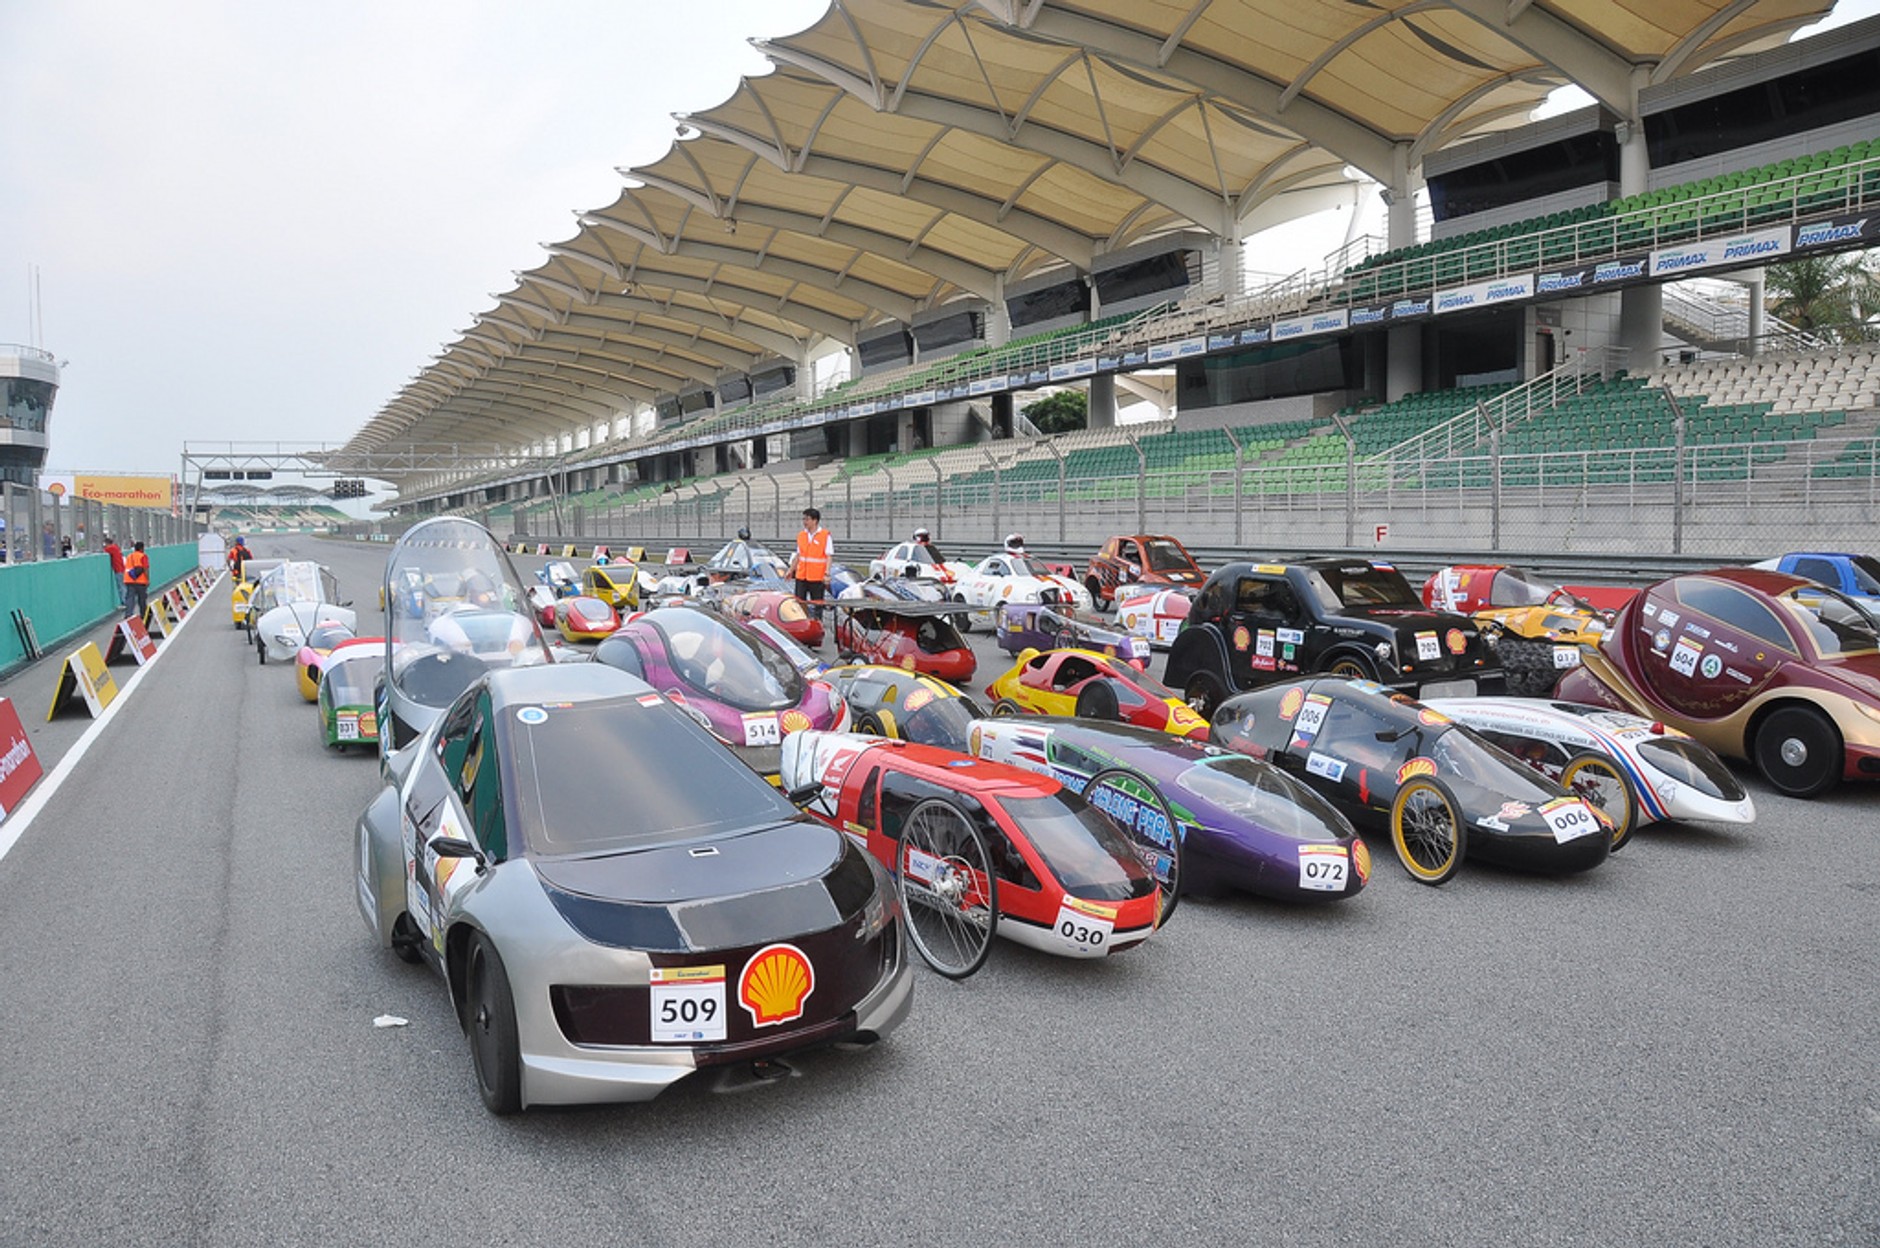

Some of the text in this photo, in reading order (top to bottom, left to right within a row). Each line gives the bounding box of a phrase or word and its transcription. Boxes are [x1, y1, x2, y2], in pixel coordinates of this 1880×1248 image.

[1797, 223, 1863, 245] PRIMAX
[1724, 240, 1780, 259] PRIMAX
[1656, 252, 1708, 271] PRIMAX
[1594, 263, 1643, 283] PRIMAX
[1486, 284, 1526, 300] PRIMAX
[82, 488, 161, 500] Eco-marathon
[1376, 525, 1388, 542] F
[1674, 651, 1695, 667] 604
[1301, 708, 1320, 724] 006
[749, 724, 776, 738] 514
[1554, 810, 1590, 830] 006
[1306, 862, 1344, 881] 072
[1061, 921, 1104, 945] 030
[661, 998, 717, 1023] 509
